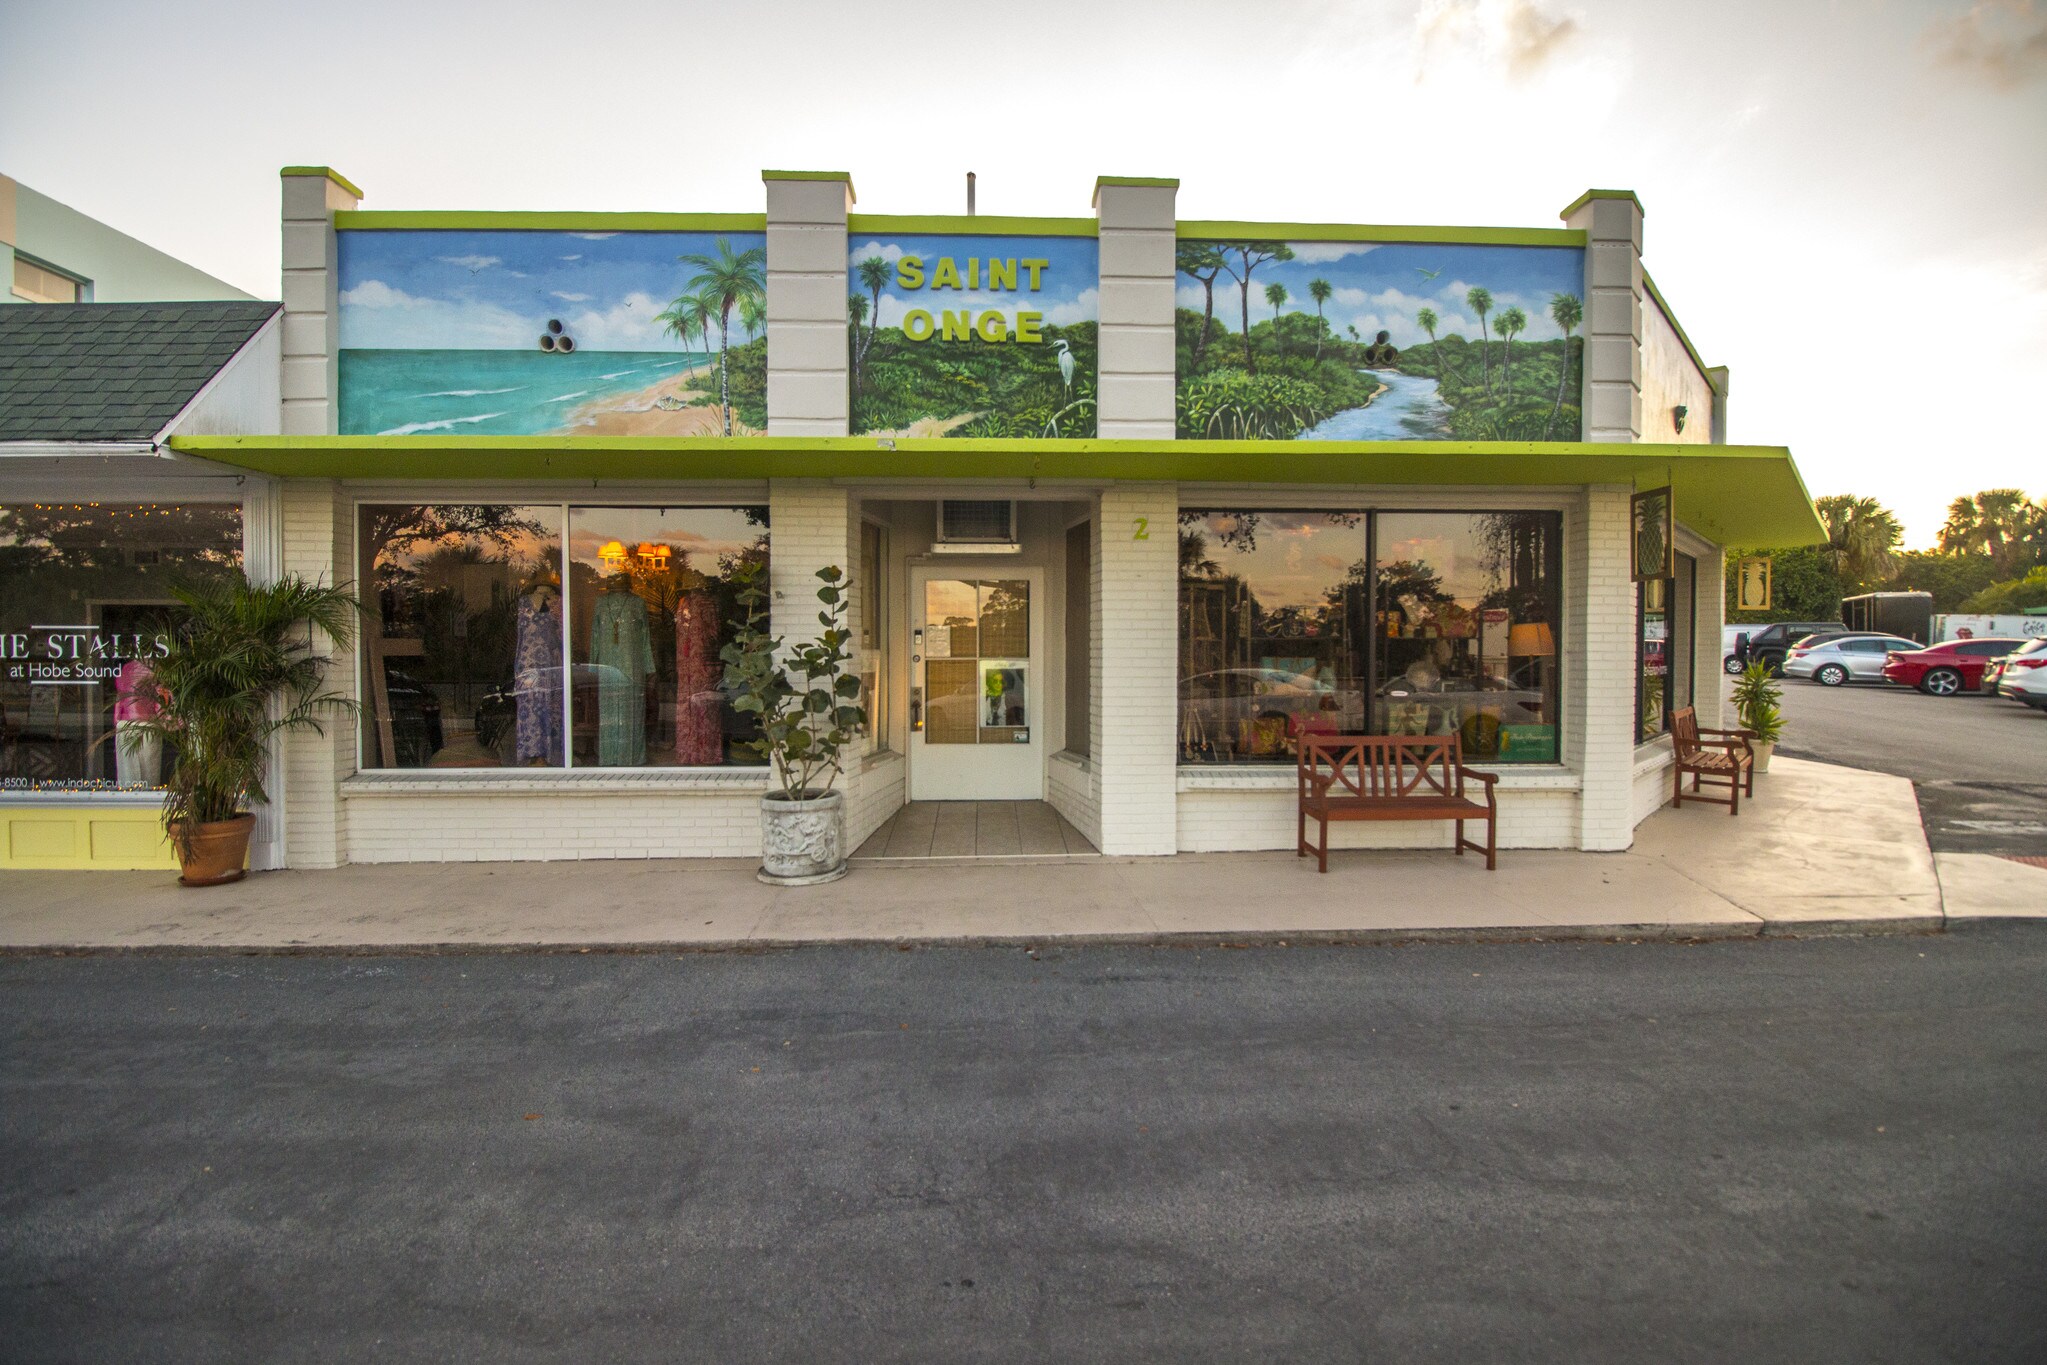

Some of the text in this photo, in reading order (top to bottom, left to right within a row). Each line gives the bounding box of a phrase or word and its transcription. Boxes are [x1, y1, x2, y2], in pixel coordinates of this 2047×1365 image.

[897, 256, 1049, 291] SAINT
[903, 308, 1043, 343] ONGE
[1133, 517, 1149, 540] 2
[47, 634, 170, 658] STALLS
[10, 662, 122, 678] at Hobe Sound
[0, 777, 28, 788] -8500
